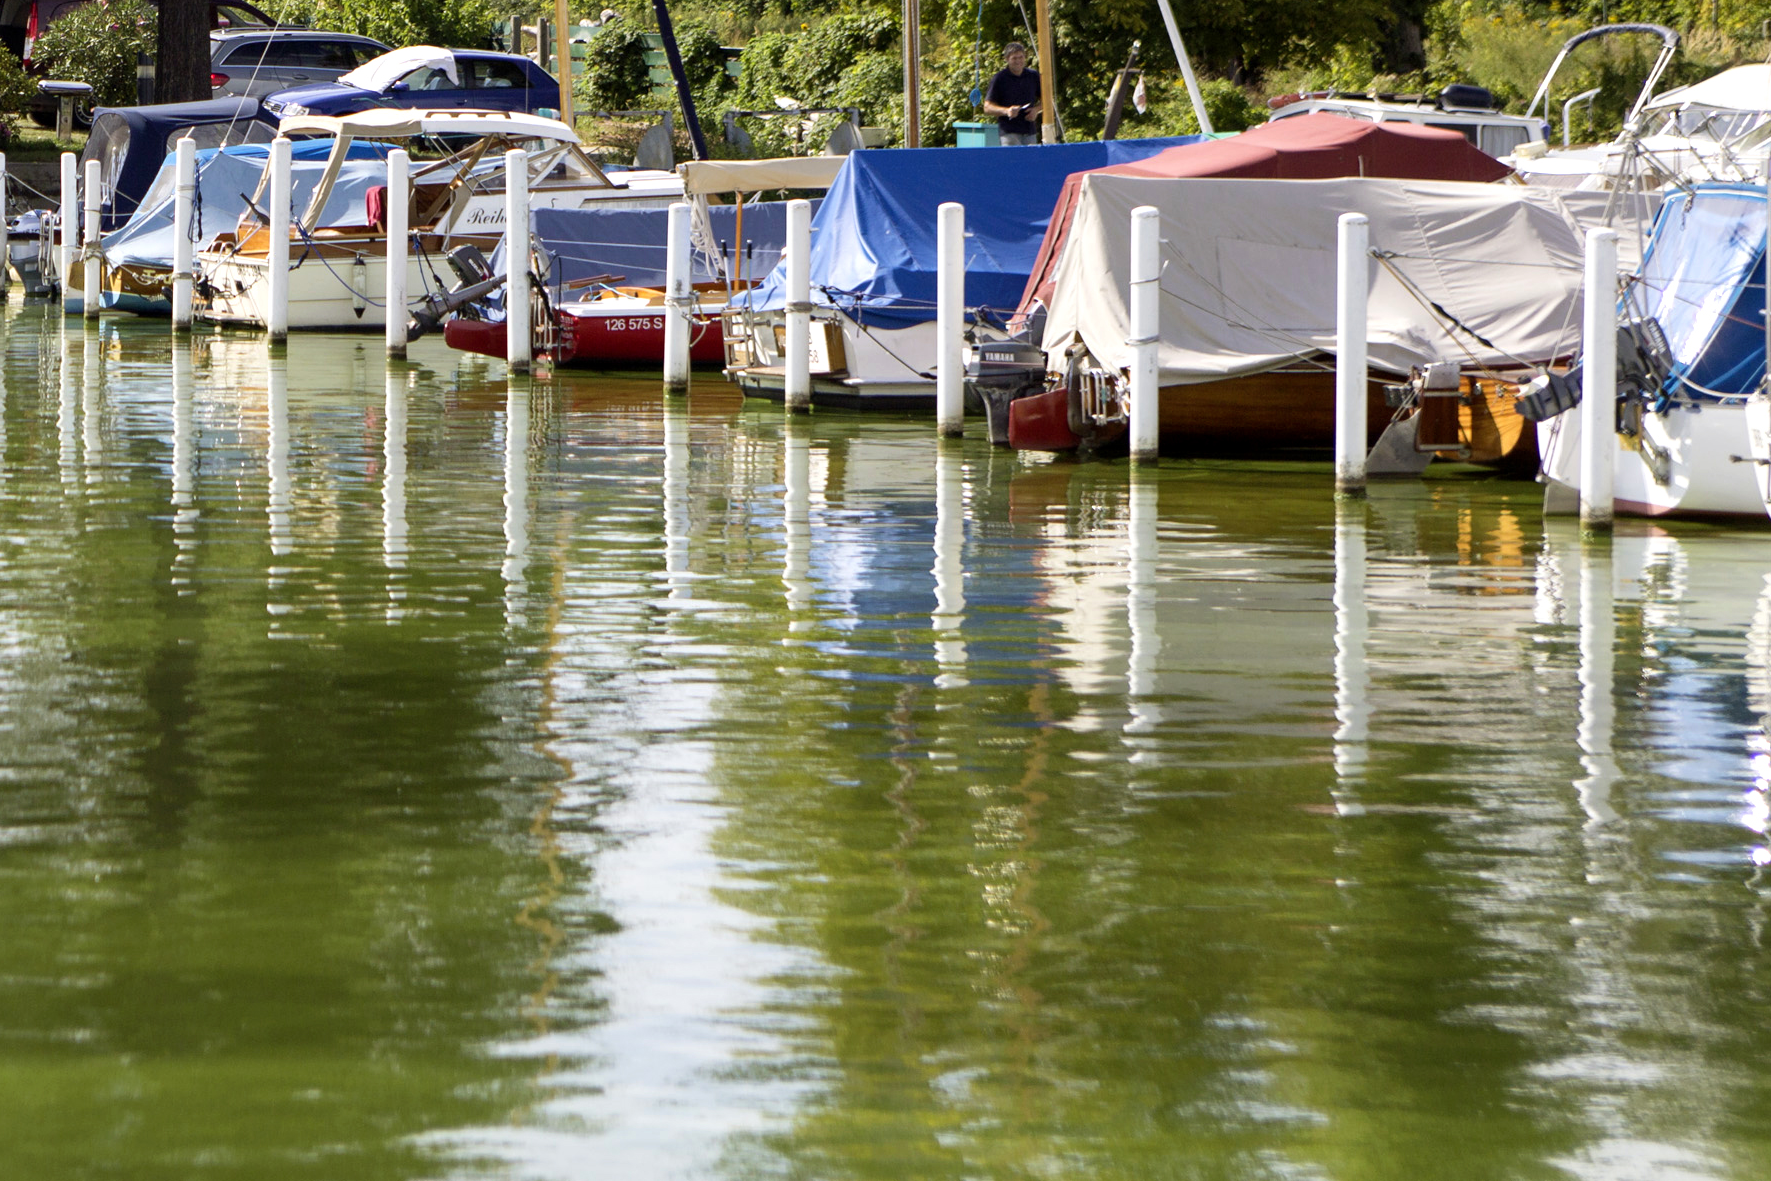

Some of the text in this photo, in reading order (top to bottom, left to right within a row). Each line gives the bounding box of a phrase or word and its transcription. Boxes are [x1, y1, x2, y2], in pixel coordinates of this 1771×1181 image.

[467, 207, 506, 225] Reih
[604, 317, 663, 331] 126 575 S
[984, 352, 1015, 362] YAMAHA
